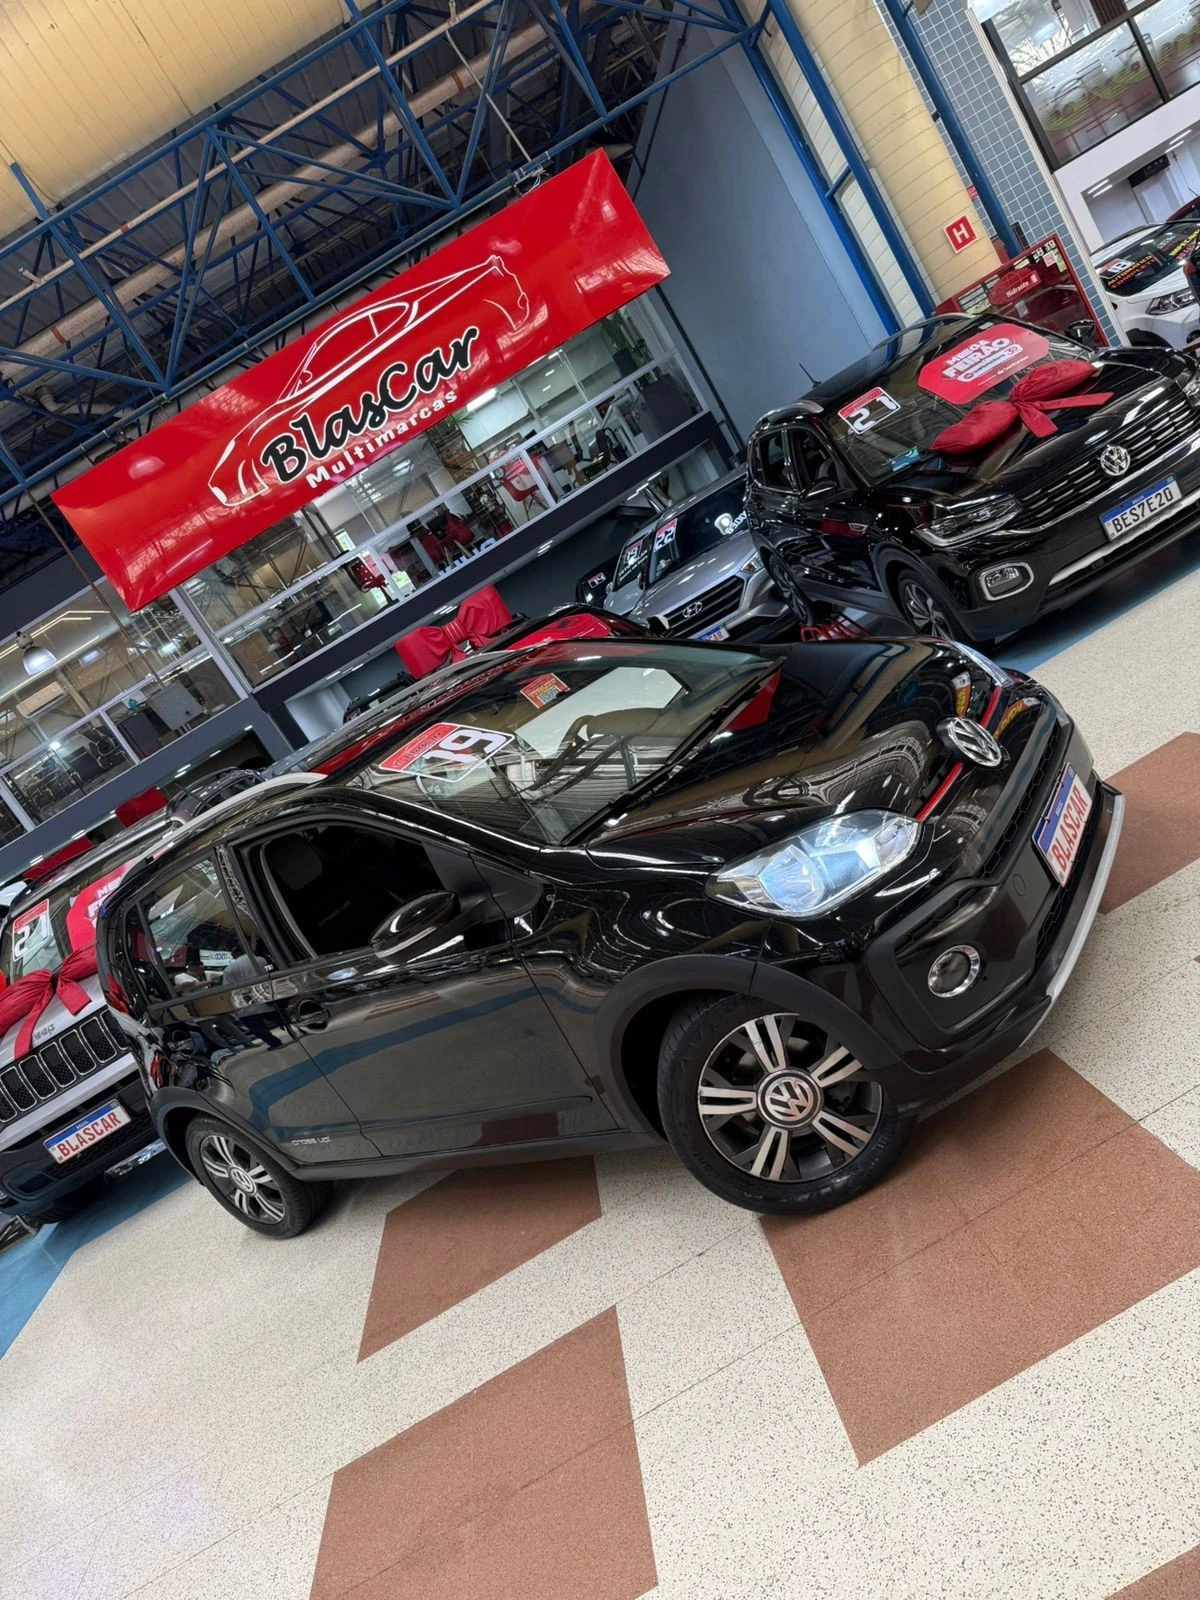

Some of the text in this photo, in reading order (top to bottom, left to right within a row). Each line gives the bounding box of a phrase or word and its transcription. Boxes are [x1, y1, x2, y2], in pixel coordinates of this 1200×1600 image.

[952, 223, 970, 244] H
[1005, 280, 1030, 298] Hidrante
[942, 337, 1011, 379] FEIRÃO
[945, 340, 991, 366] MEGA
[260, 325, 480, 484] BlasCar
[850, 395, 898, 433] 21
[305, 391, 458, 489] Multimarcas
[1112, 487, 1174, 533] BES7E20
[655, 526, 676, 549] 22
[424, 729, 507, 764] 19
[1051, 785, 1088, 870] BLASCAR
[15, 912, 48, 957] 21
[56, 1112, 122, 1157] BLASCAR
